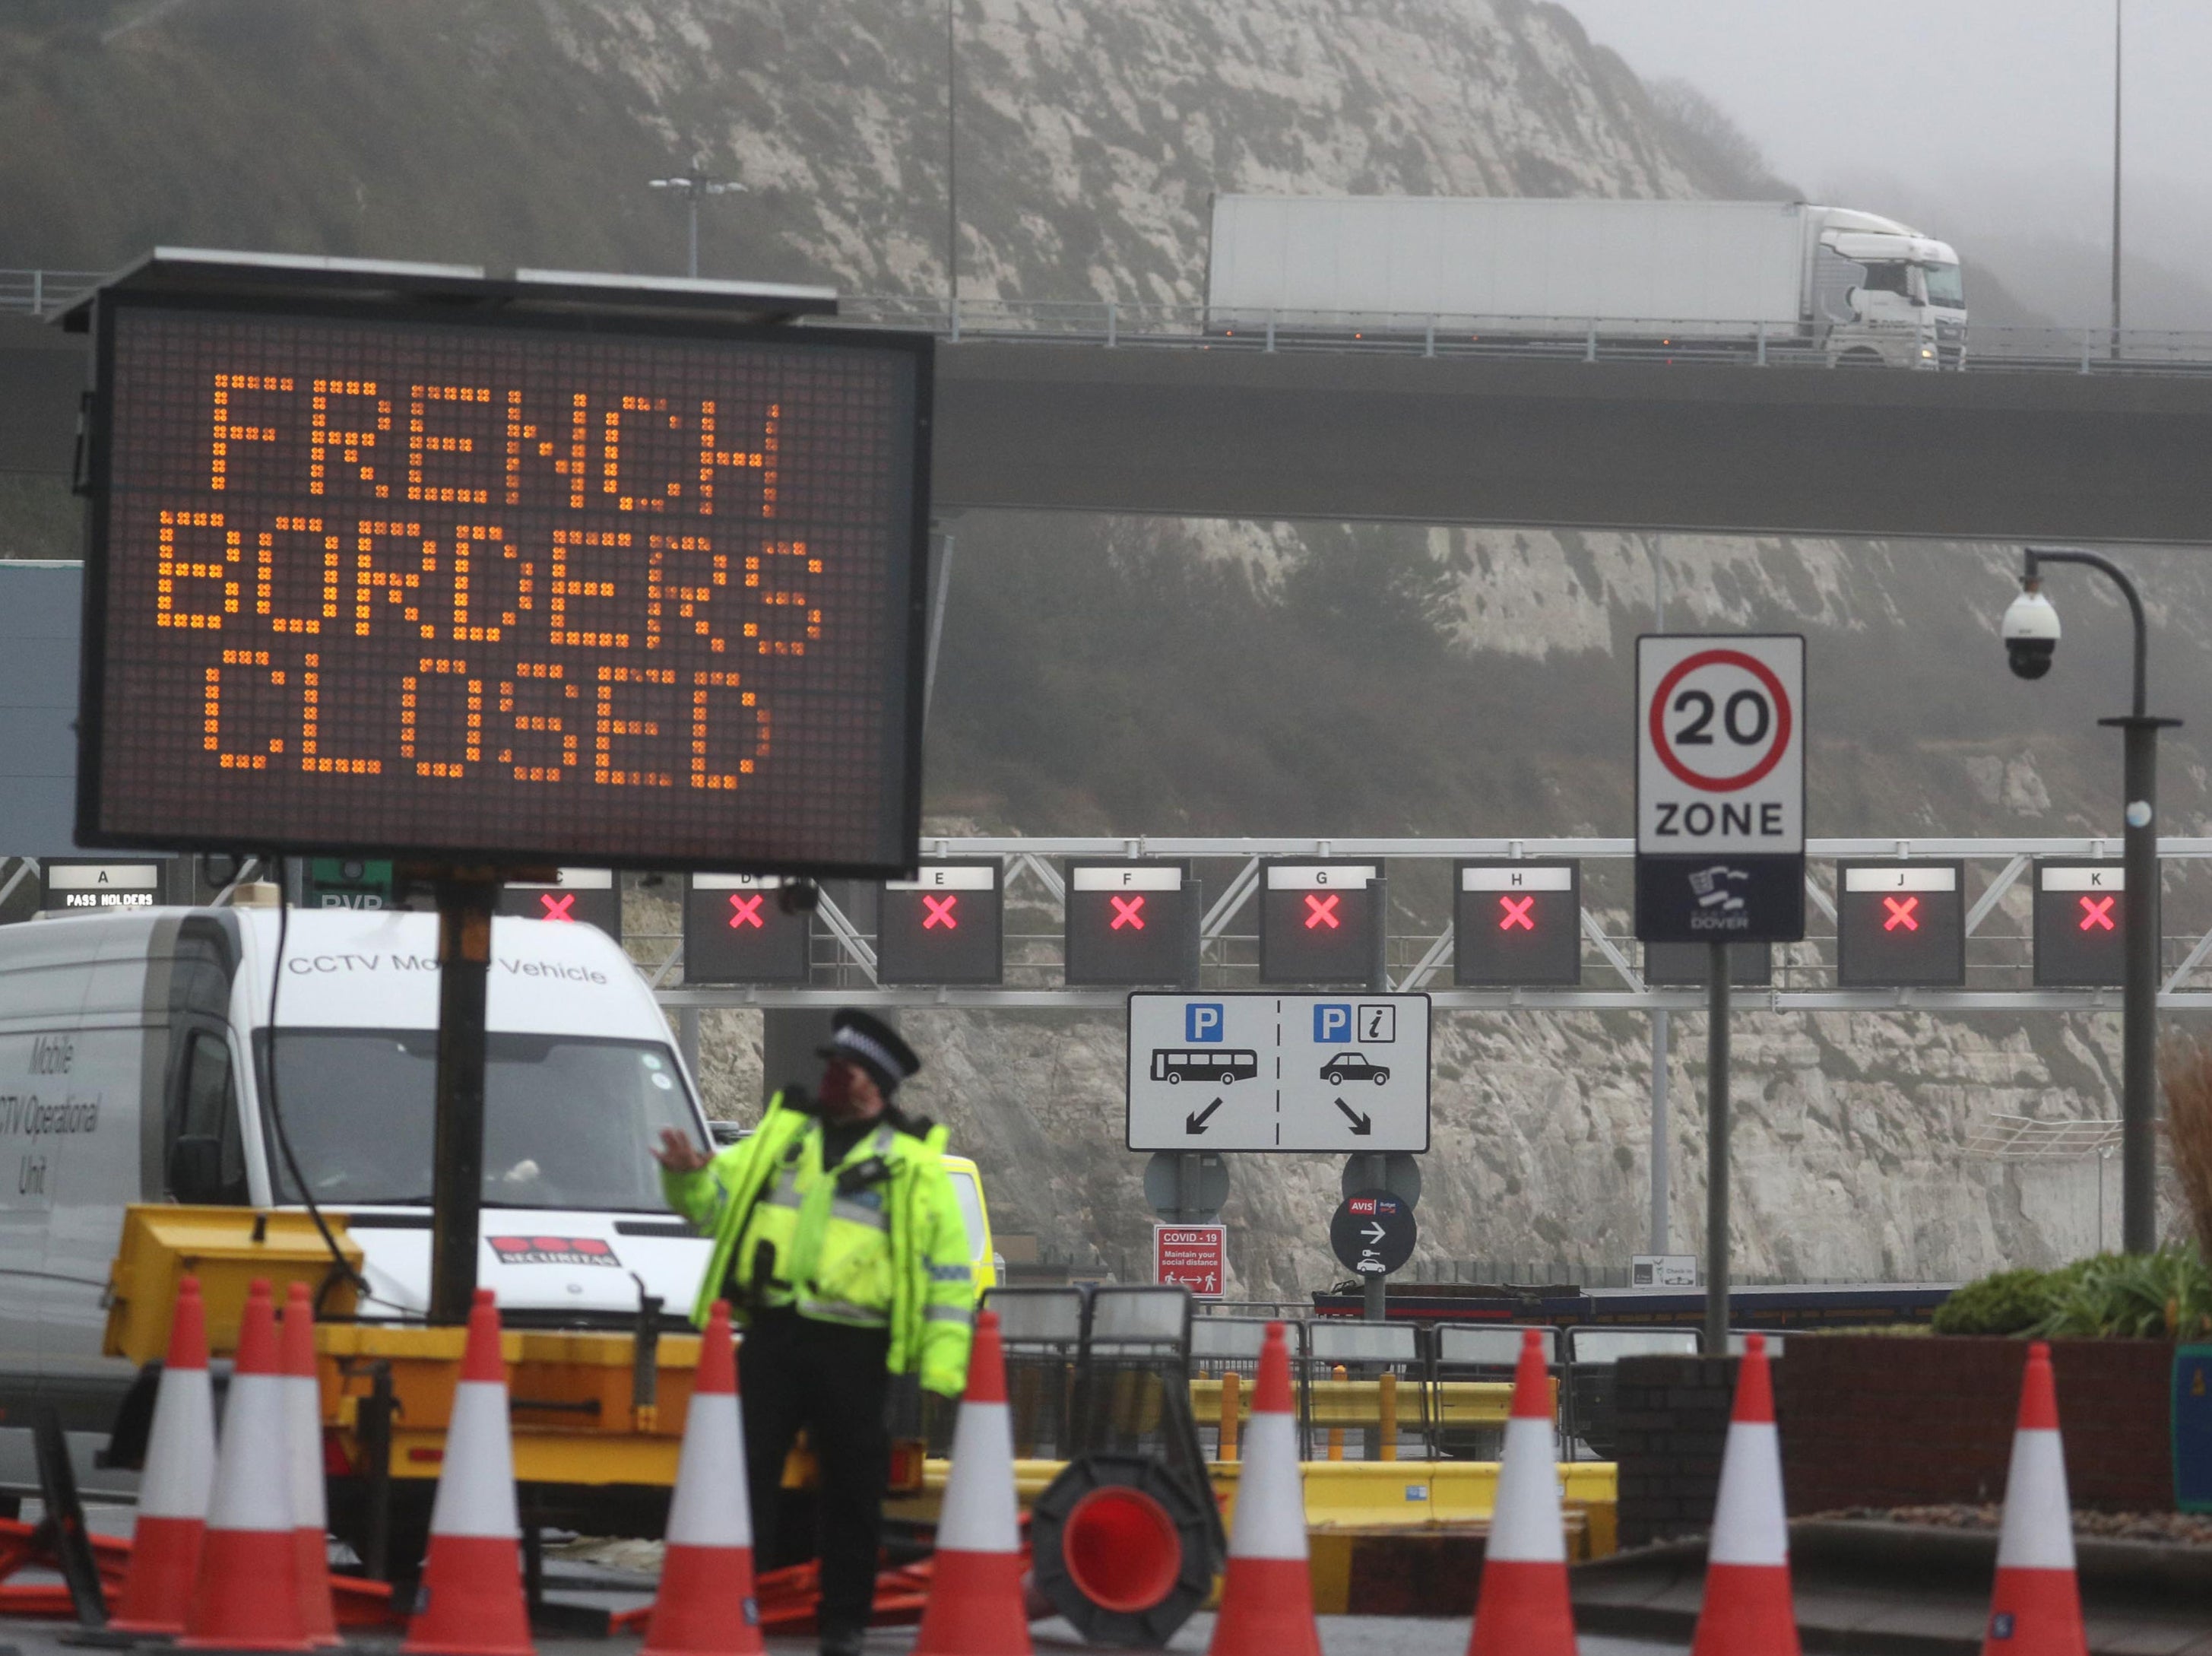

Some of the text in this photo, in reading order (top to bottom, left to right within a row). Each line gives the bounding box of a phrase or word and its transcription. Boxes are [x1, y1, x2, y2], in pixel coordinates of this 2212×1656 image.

[211, 373, 779, 517] FRENCH
[157, 509, 822, 655] BORDERS
[203, 649, 770, 790] CLOSED
[1674, 690, 1770, 746] 20
[1655, 802, 1784, 837] ZONE
[97, 871, 109, 884] A
[741, 874, 751, 884] D
[935, 872, 944, 885] E
[1123, 873, 1132, 886] F
[1316, 872, 1327, 885] G
[1511, 873, 1523, 886] H
[1897, 874, 1904, 887] J
[2091, 873, 2102, 886] K
[66, 893, 153, 906] PASS HOLDERS
[287, 955, 379, 976] CCTV
[499, 958, 607, 985] Vehicle
[1196, 1007, 1218, 1039] P
[1323, 1008, 1346, 1039] P
[30, 1036, 74, 1074] Mobile
[24, 1093, 102, 1144] Operational
[19, 1154, 47, 1194] Unit
[1352, 1202, 1373, 1210] AVIS
[1163, 1232, 1197, 1242] COVID
[1206, 1233, 1217, 1242] 19
[1198, 1252, 1216, 1261] your
